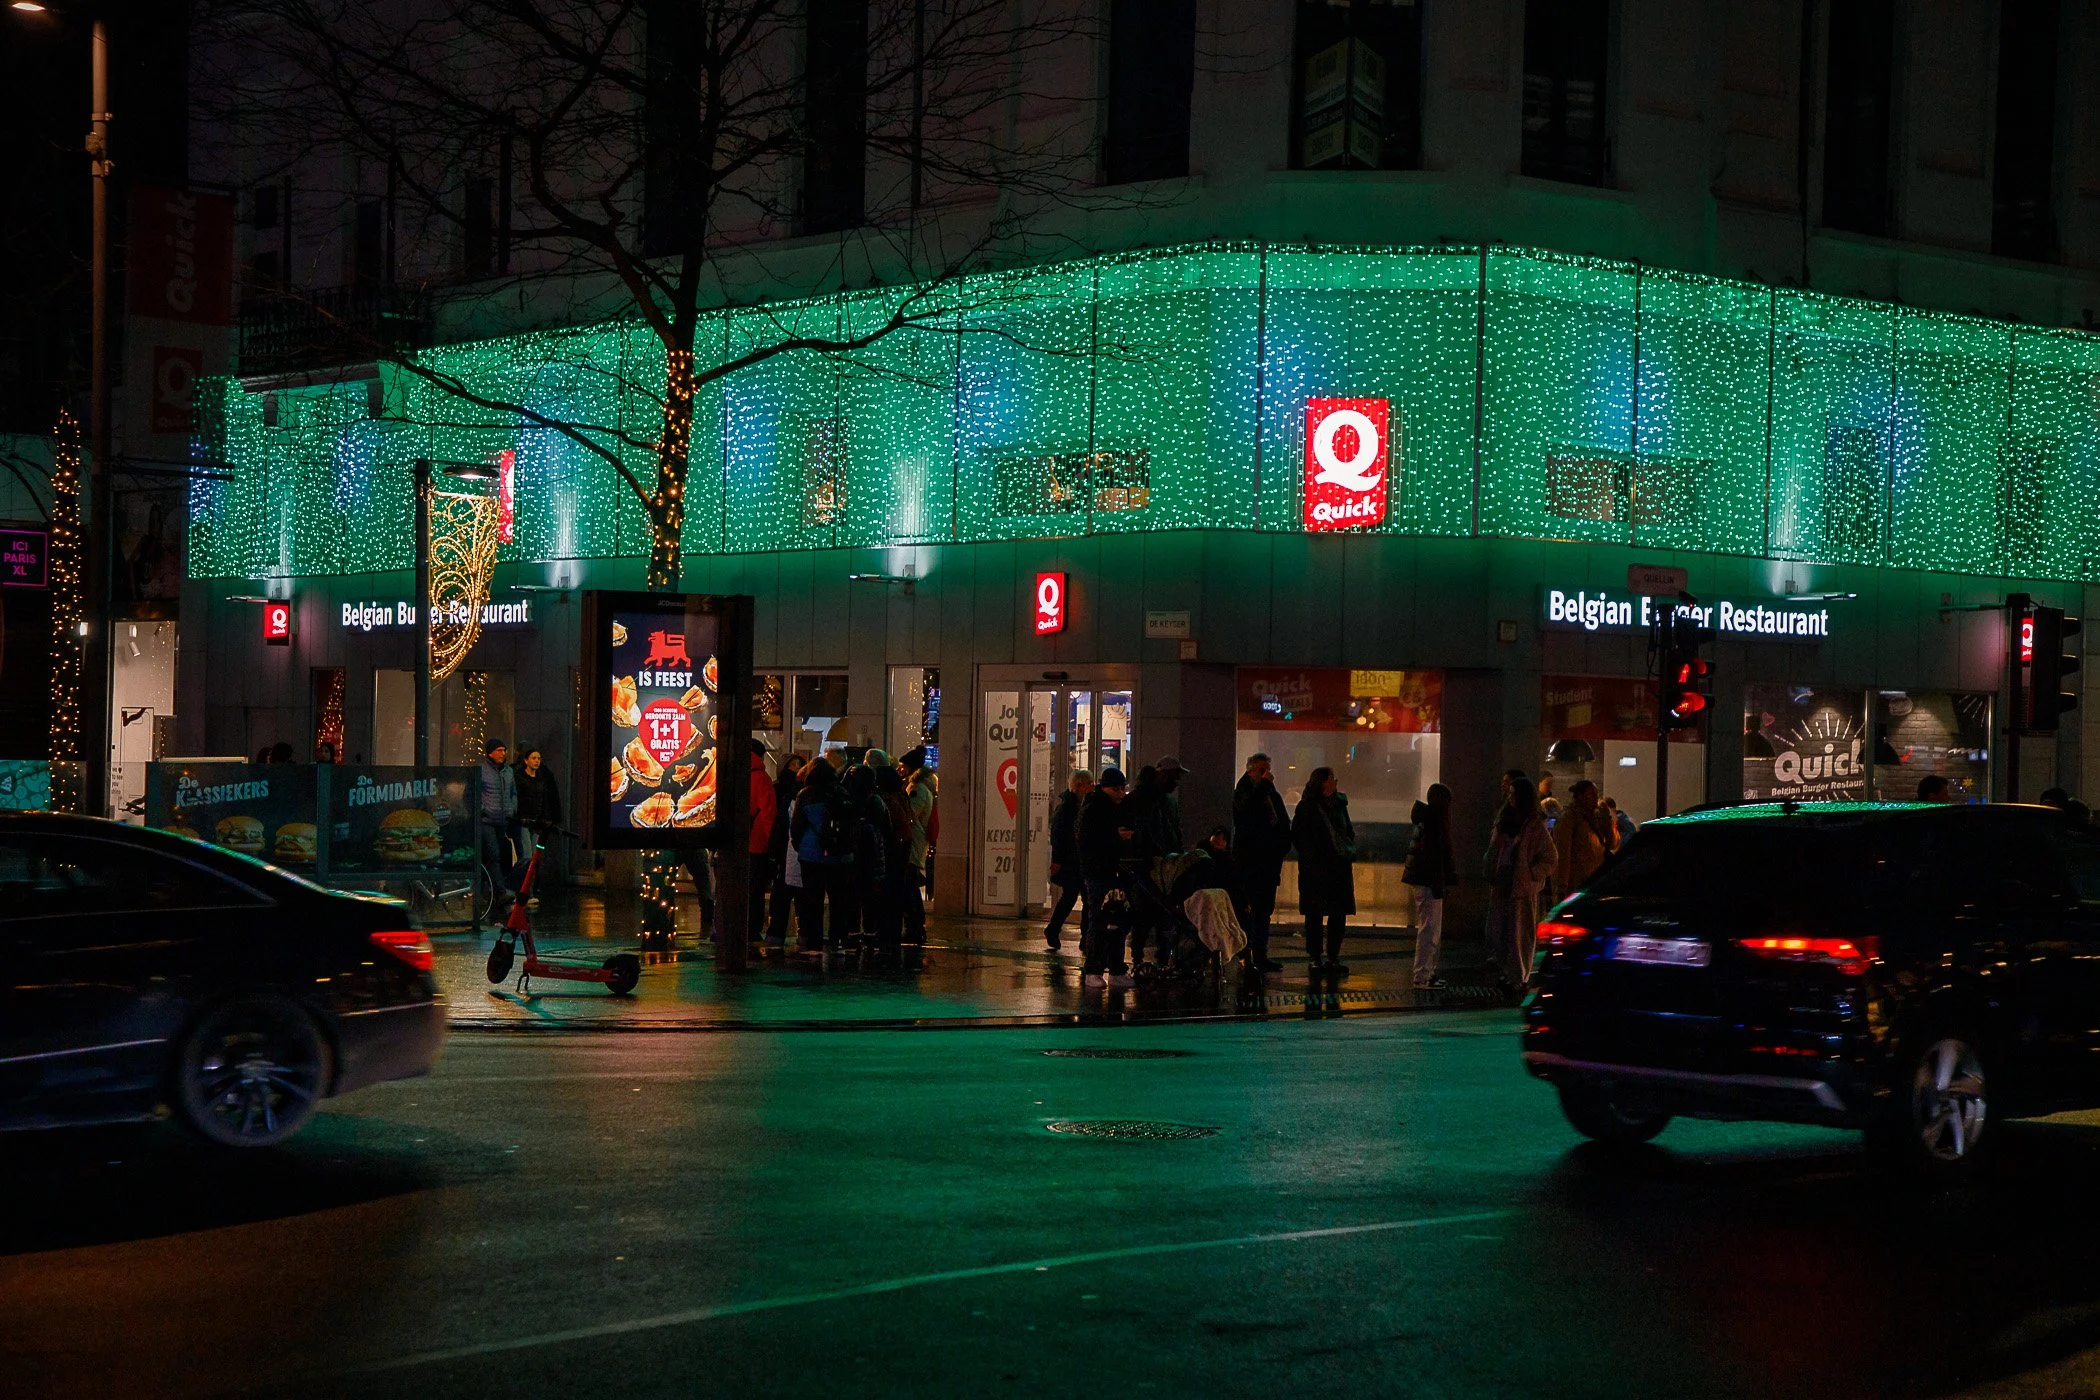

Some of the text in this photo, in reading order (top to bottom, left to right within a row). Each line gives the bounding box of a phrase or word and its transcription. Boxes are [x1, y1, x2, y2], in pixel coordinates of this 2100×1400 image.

[165, 190, 198, 313] Quick
[158, 357, 197, 410] Q
[1313, 409, 1382, 492] Q
[1313, 495, 1378, 524] Quick
[12, 541, 28, 551] ICI
[3, 552, 37, 564] PARIS
[12, 565, 27, 575] XL
[1038, 577, 1060, 617] Q
[272, 608, 287, 628] Q
[342, 599, 528, 632] Belgian Buer Reaurant
[1550, 590, 1632, 631] Belgian
[1720, 601, 1829, 636] Restaurant
[638, 671, 693, 687] IS FEEST
[1251, 672, 1312, 699] Quick
[650, 720, 679, 739] 1+1
[989, 719, 1041, 743] Quik
[179, 776, 199, 789] De
[357, 775, 373, 786] De
[1771, 779, 1864, 797] Belgian Burger Restaur
[348, 778, 438, 807] FORMIDABLE
[986, 829, 1037, 843] KEYSEEI
